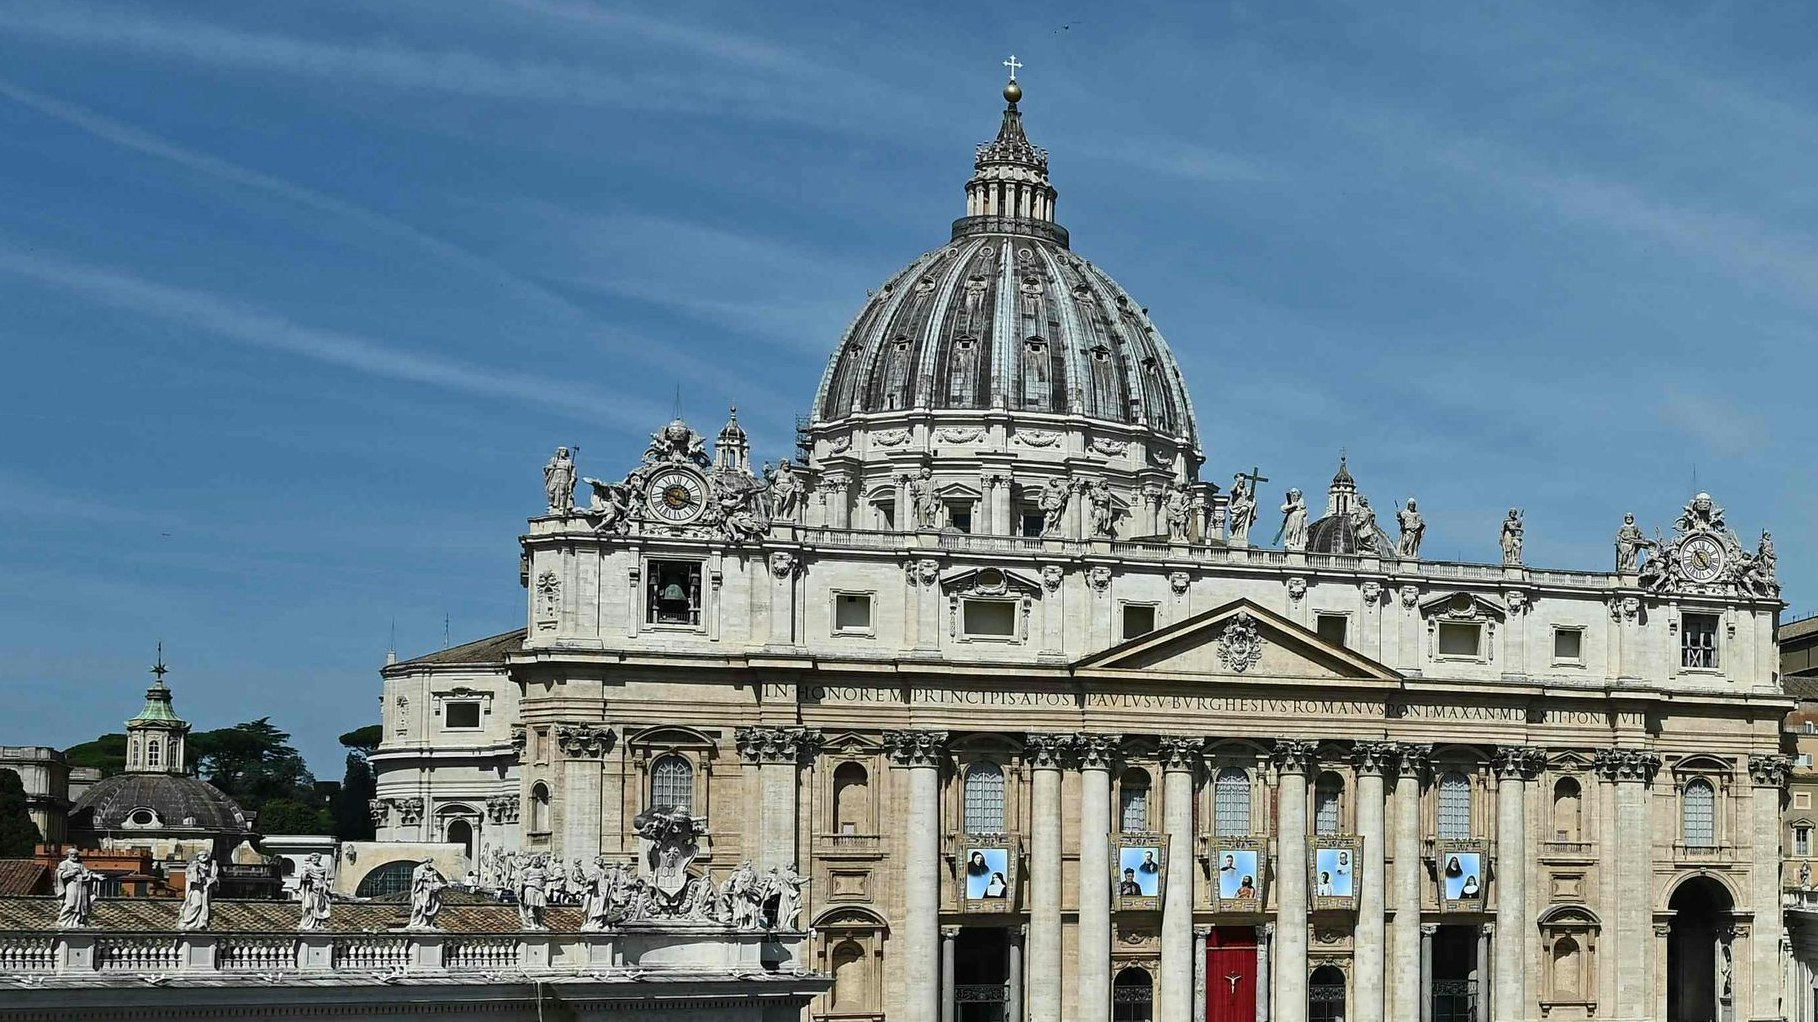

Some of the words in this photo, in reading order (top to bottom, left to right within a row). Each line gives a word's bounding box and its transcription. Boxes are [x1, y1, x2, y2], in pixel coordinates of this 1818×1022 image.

[764, 684, 788, 698] IN
[798, 686, 905, 702] HONOREM
[913, 688, 1016, 706] PRINCIPIS
[1088, 694, 1151, 709] PAVLVS
[1155, 695, 1167, 709] V
[1172, 696, 1288, 713] BVRGHESIVS
[1293, 700, 1385, 716] ROMANVS
[1433, 705, 1471, 719] MAX
[1473, 707, 1496, 720] AN
[1618, 713, 1643, 725] VII
